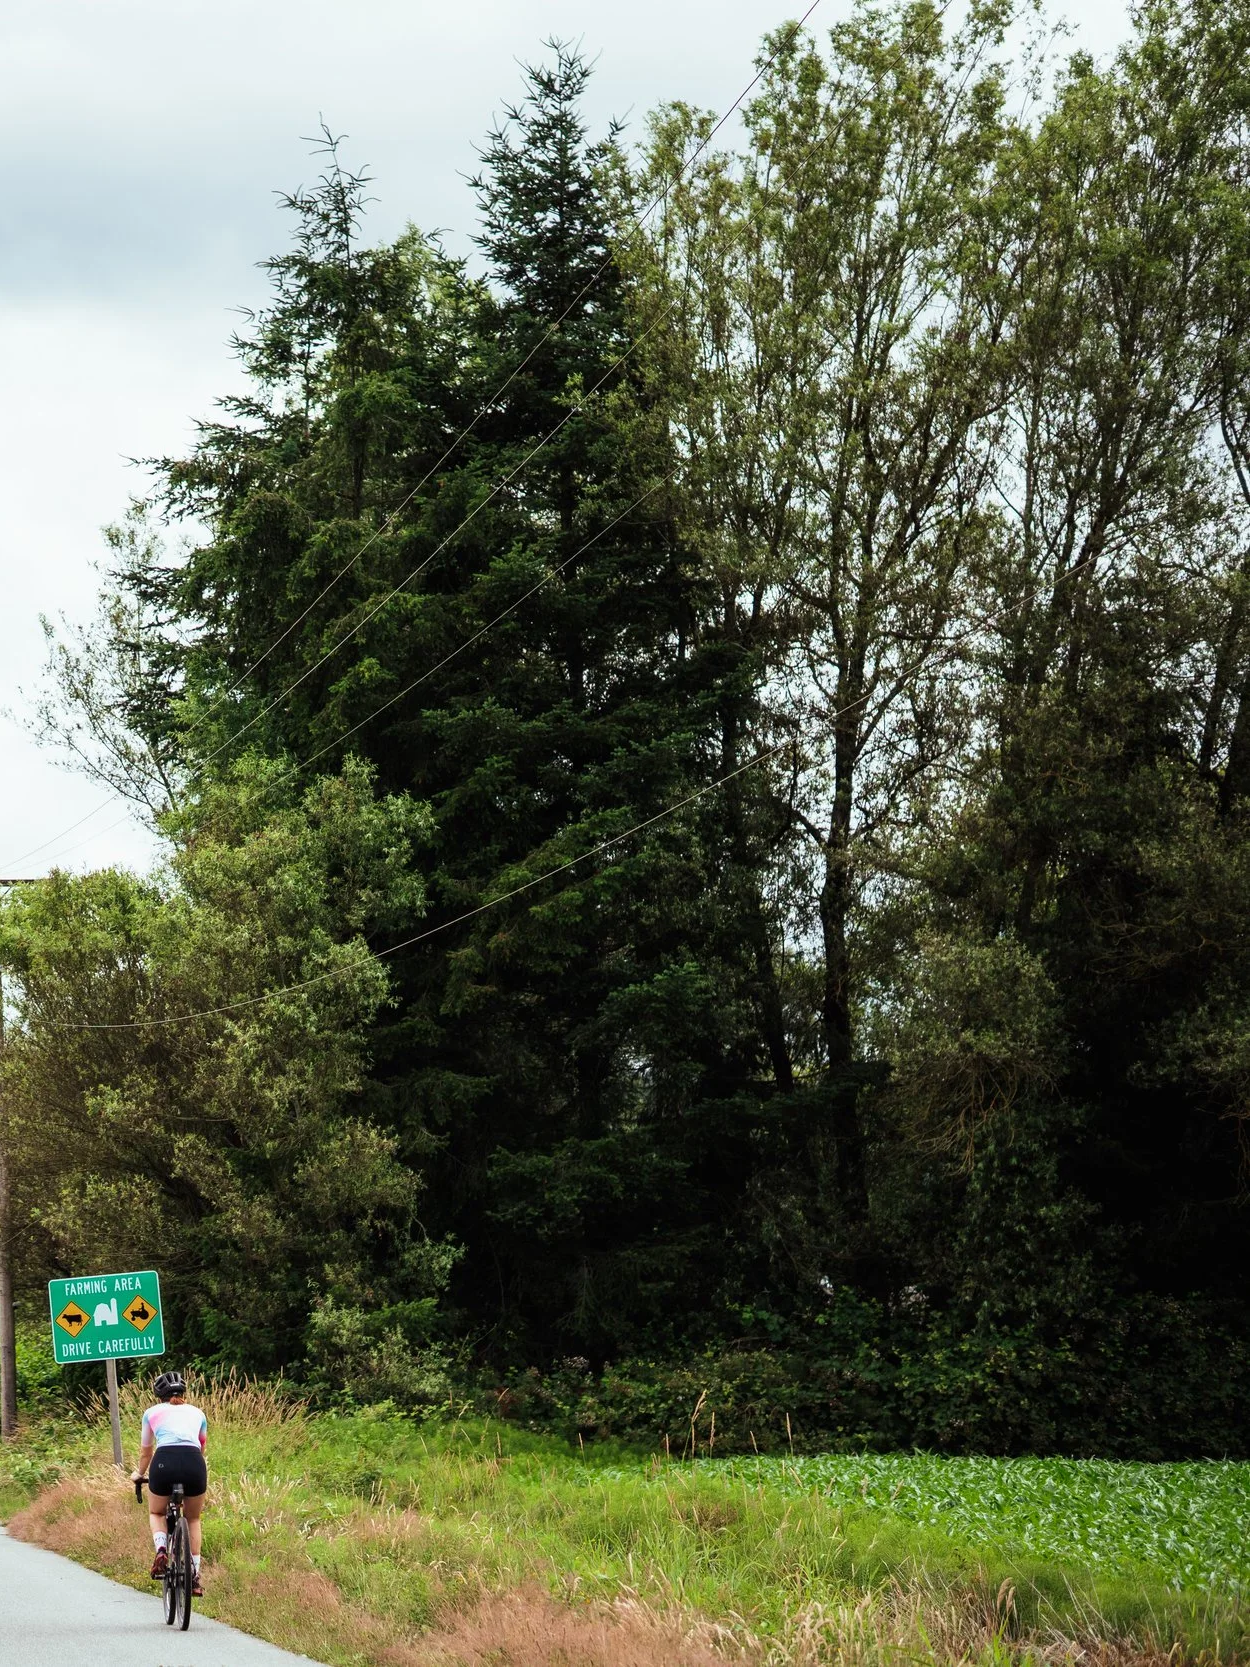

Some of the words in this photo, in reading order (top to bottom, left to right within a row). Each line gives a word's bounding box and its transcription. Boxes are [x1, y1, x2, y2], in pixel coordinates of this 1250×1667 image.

[65, 1280, 107, 1296] FARMING
[114, 1277, 142, 1292] AREA
[62, 1341, 92, 1357] DRIVE
[98, 1336, 155, 1354] CAREFULLY
